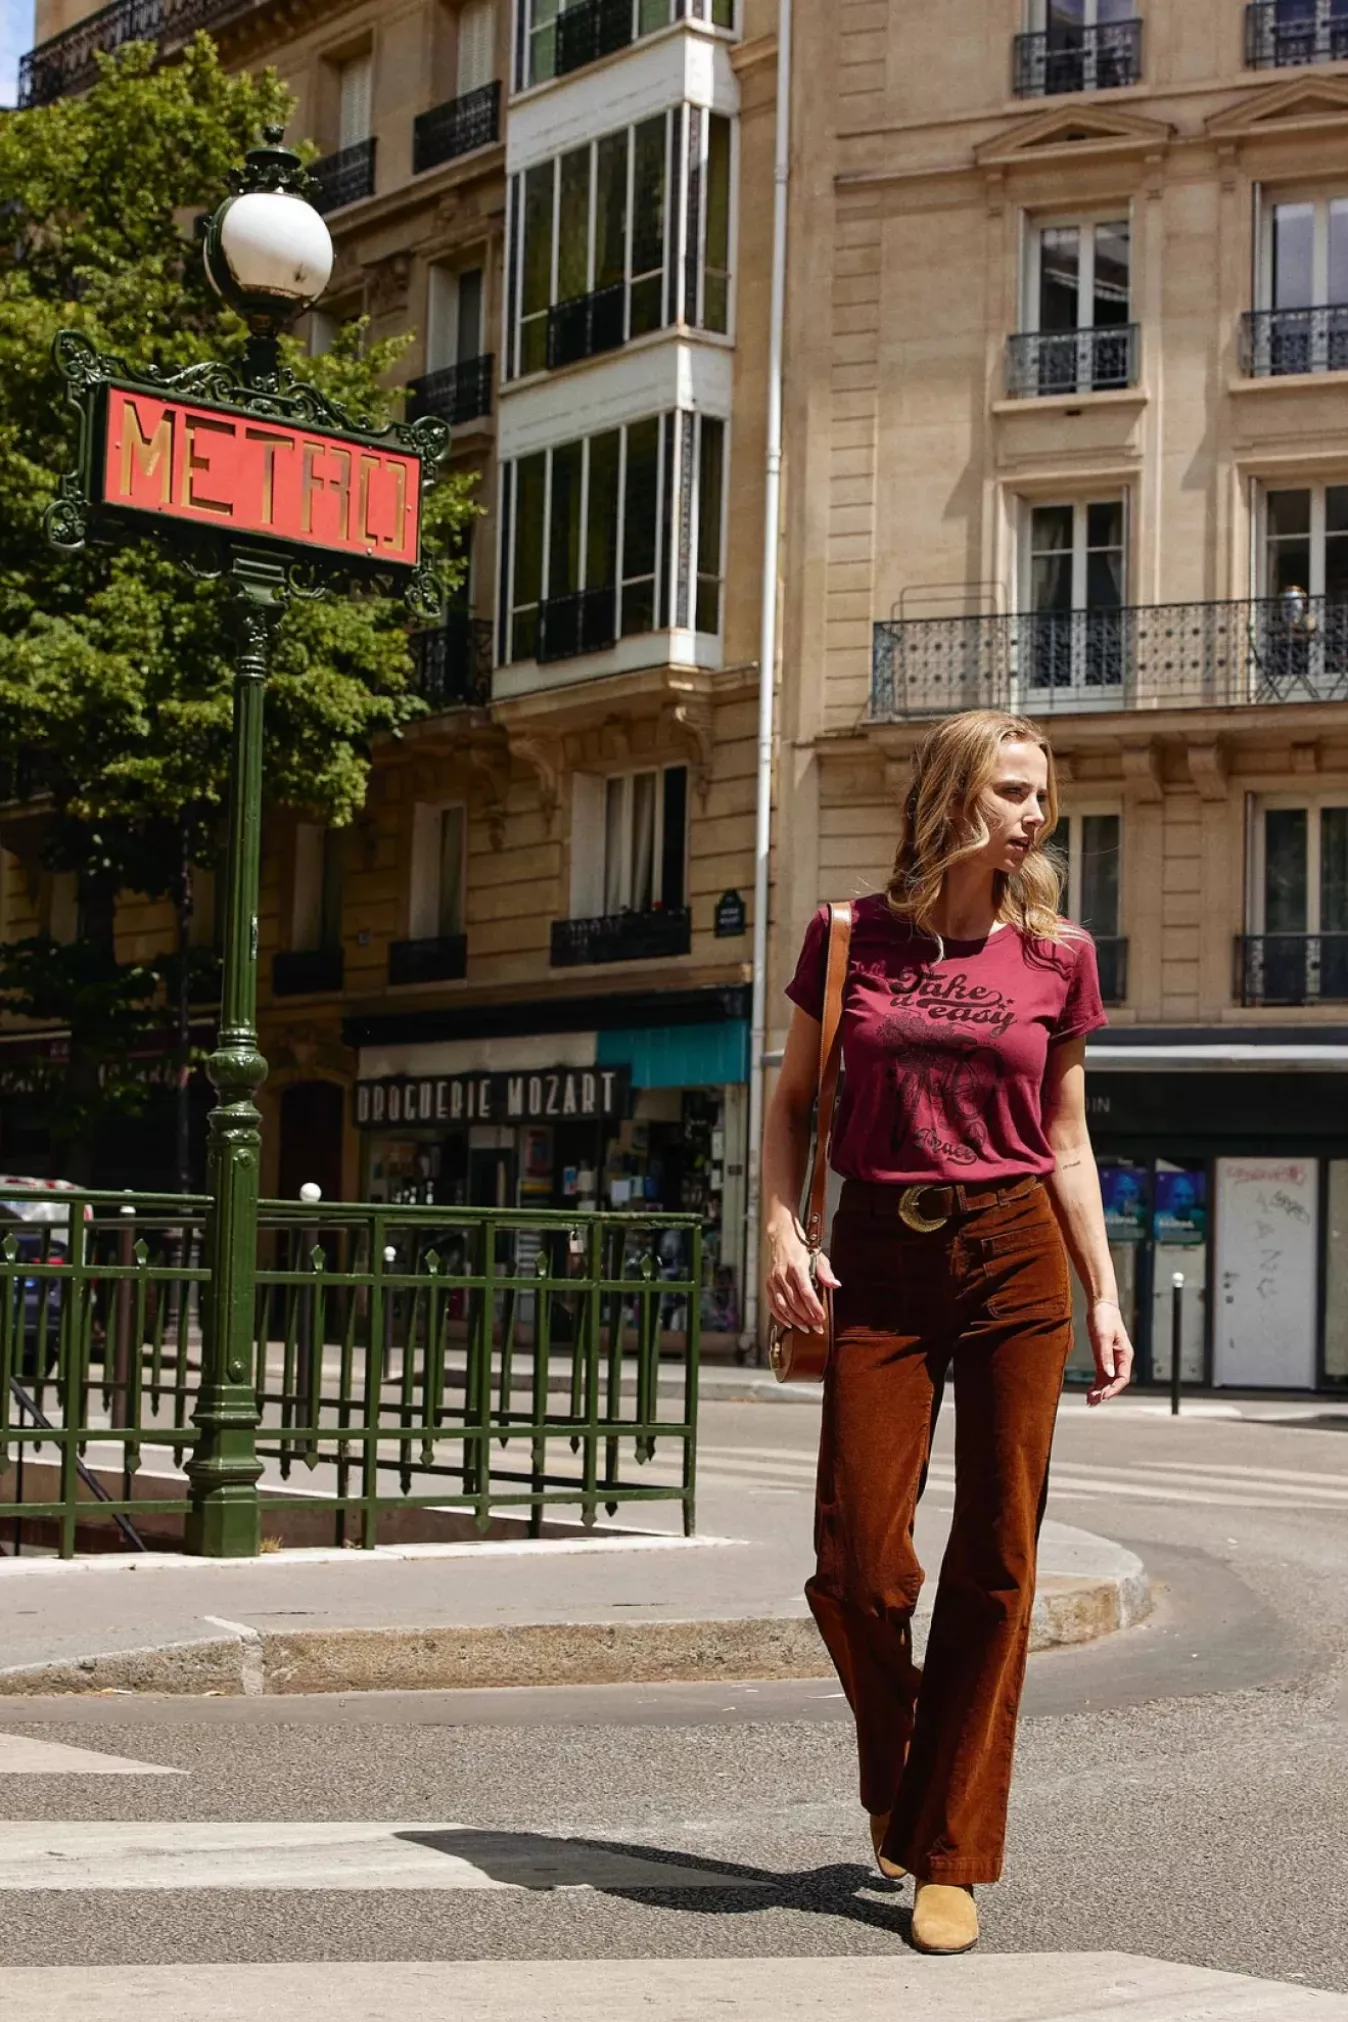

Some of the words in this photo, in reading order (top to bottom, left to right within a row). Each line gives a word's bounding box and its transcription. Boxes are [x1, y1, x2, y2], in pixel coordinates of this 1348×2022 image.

[119, 398, 408, 553] METRO
[889, 967, 1003, 1007] Take
[927, 1006, 1018, 1038] easy
[356, 1078, 493, 1123] DROGUERIE
[507, 1071, 617, 1117] MOZART
